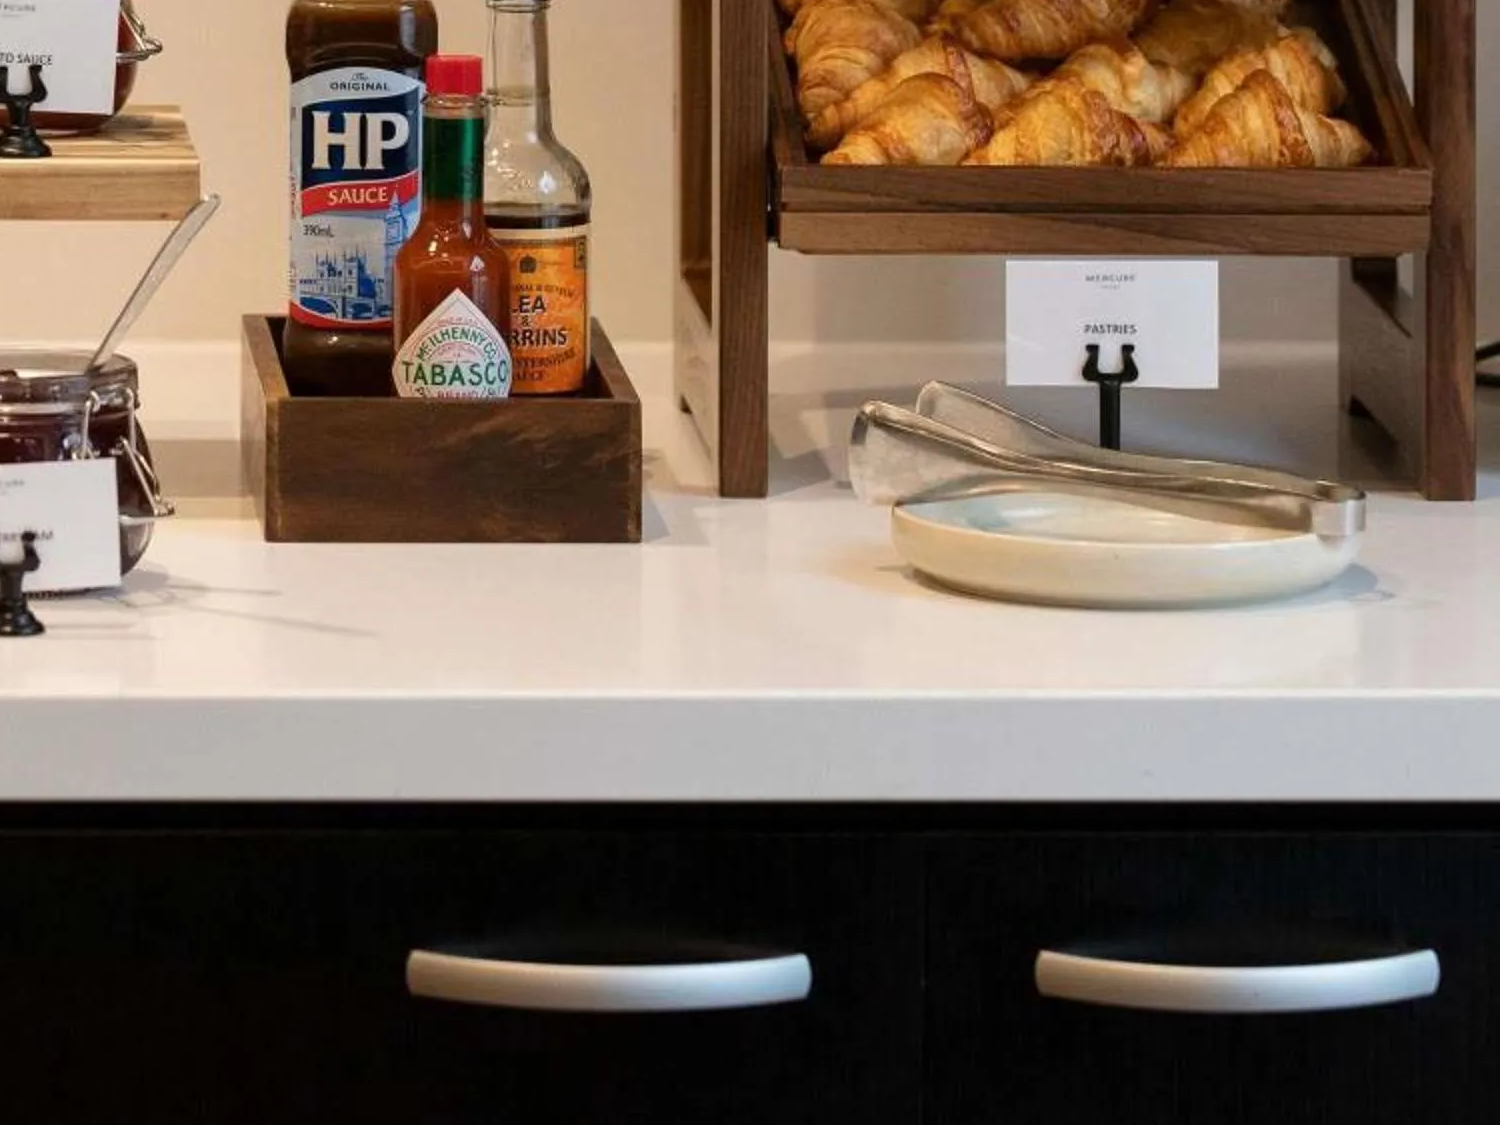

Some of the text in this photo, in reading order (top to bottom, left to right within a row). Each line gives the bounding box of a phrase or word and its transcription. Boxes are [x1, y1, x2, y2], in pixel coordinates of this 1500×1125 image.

[16, 53, 53, 66] SAUCE
[329, 81, 389, 92] ORIGINAL
[311, 111, 410, 170] HP
[327, 186, 389, 206] SAUCE
[509, 296, 546, 313] EA
[509, 325, 567, 346] RRINS
[1083, 323, 1138, 336] PASTRIES
[401, 359, 510, 386] TABASCO
